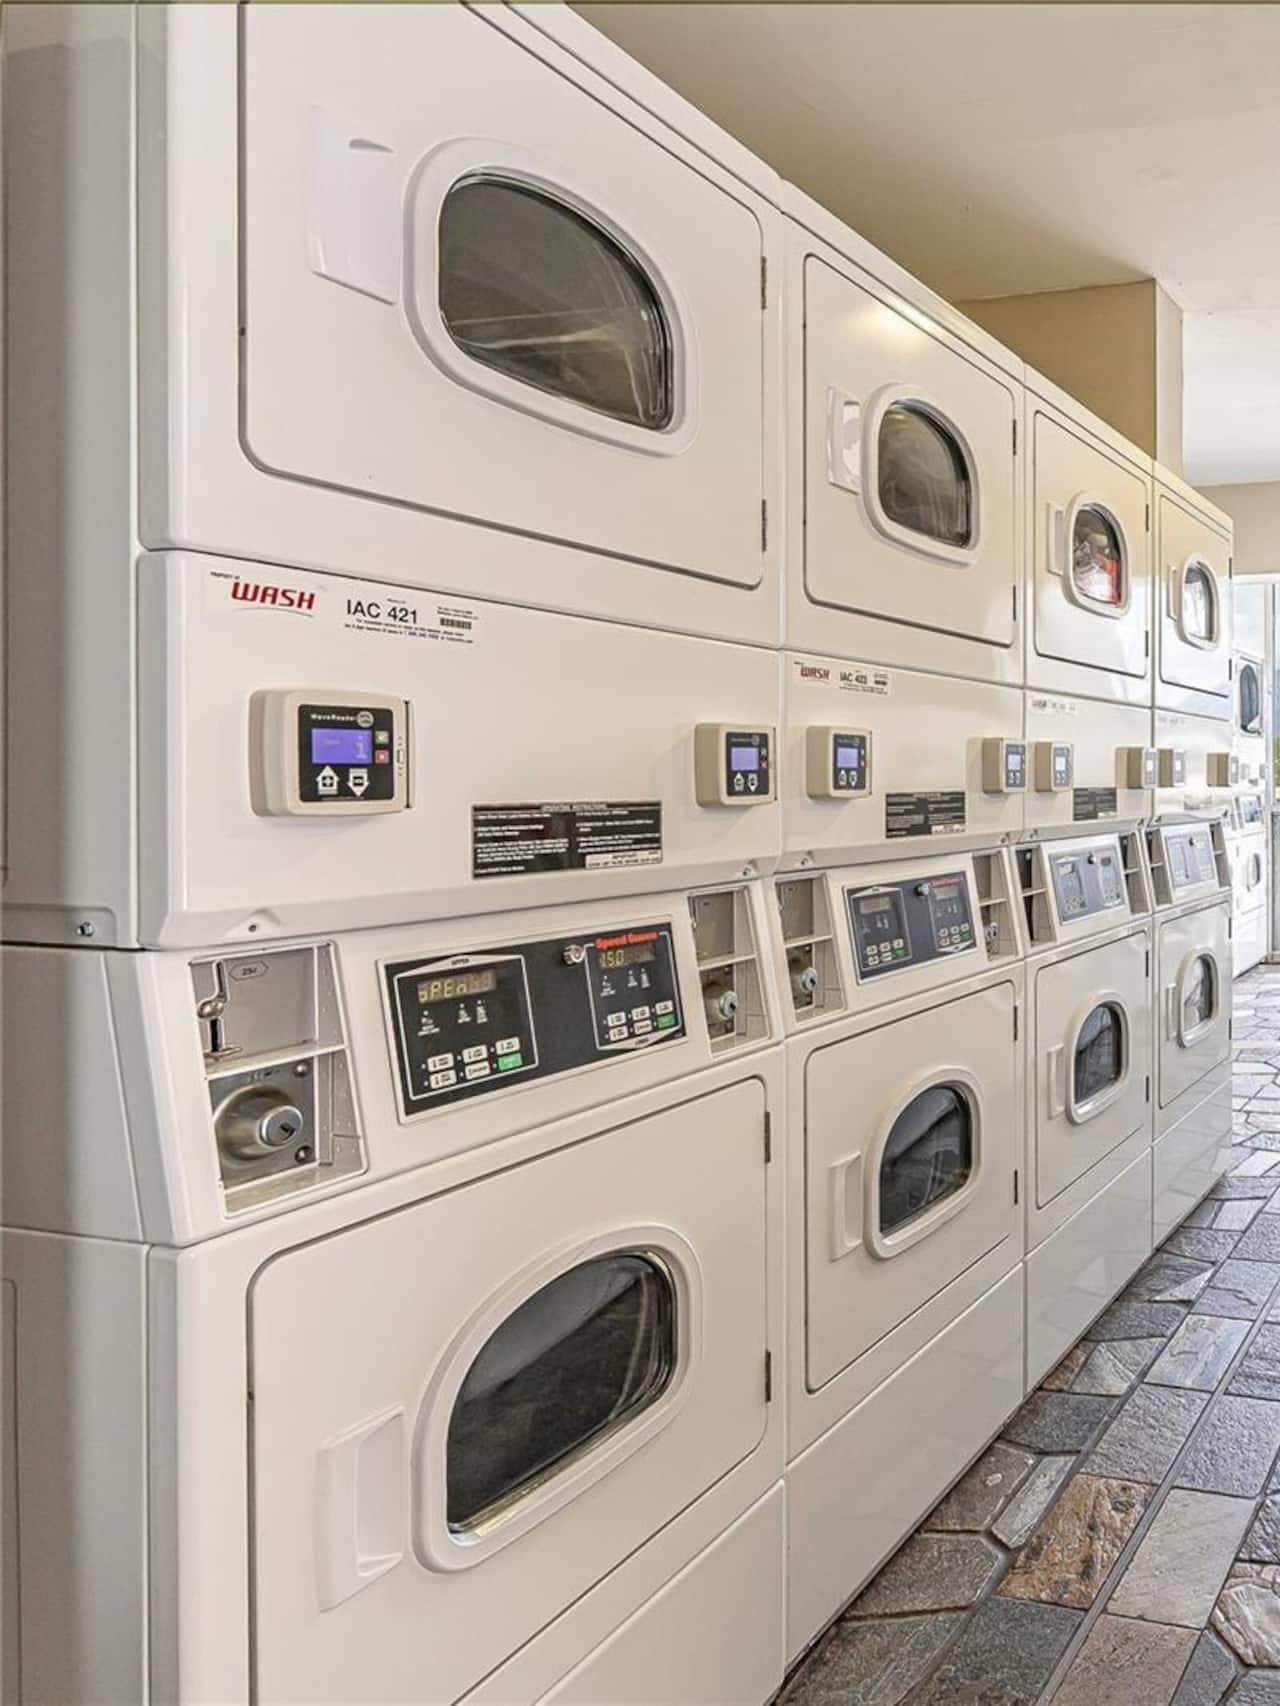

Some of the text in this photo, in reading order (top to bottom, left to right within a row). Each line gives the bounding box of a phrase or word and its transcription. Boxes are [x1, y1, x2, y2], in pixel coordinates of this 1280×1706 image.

[231, 581, 316, 610] WASH
[346, 598, 381, 619] IAC
[387, 606, 417, 625] 421
[800, 666, 831, 681] WASH
